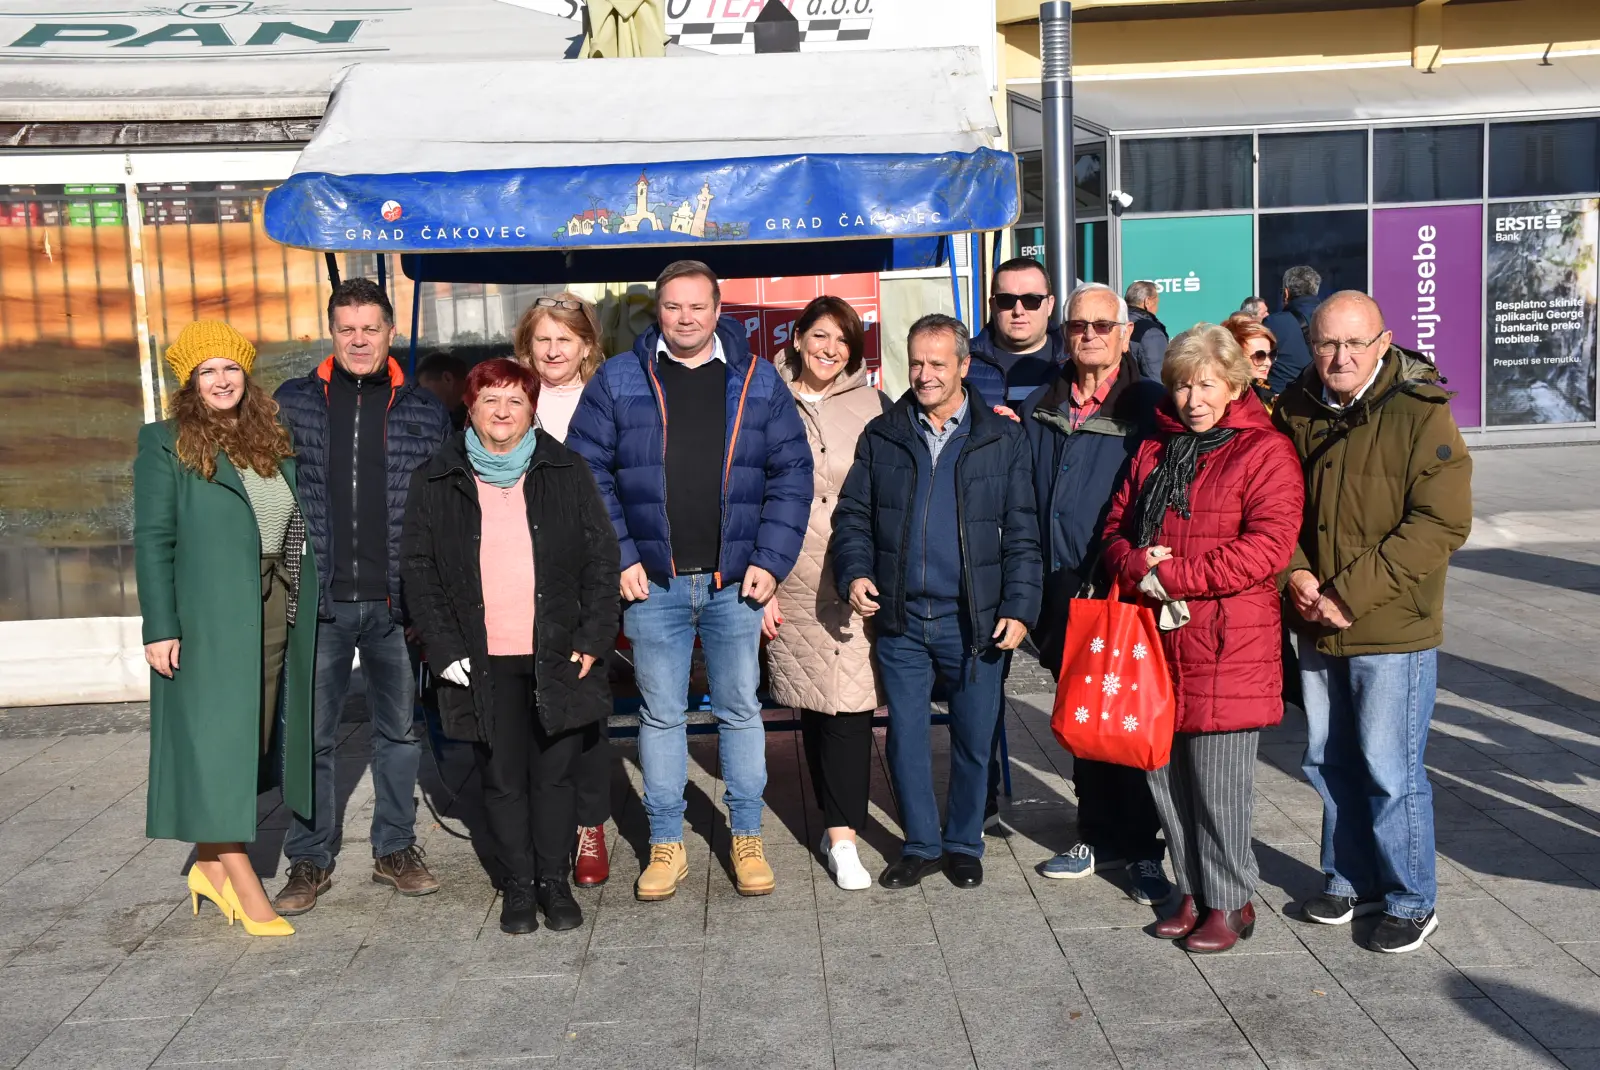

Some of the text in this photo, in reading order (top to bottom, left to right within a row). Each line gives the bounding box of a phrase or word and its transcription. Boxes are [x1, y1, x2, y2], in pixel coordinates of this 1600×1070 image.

[6, 19, 368, 48] PAN
[765, 211, 942, 230] GRAD ČAKOVEC
[1495, 215, 1544, 232] ERSTE
[345, 224, 527, 241] GRAD ČAKOVEC
[1495, 232, 1520, 242] Bank
[1133, 278, 1182, 293] STE
[1495, 298, 1584, 312] Besplatno skinite
[1495, 310, 1584, 323] aplikaciju George
[1500, 322, 1549, 333] bankarite
[1551, 321, 1581, 332] preko
[1495, 334, 1542, 345] mobitela.
[1493, 355, 1582, 367] Prepusti se trenutku.
